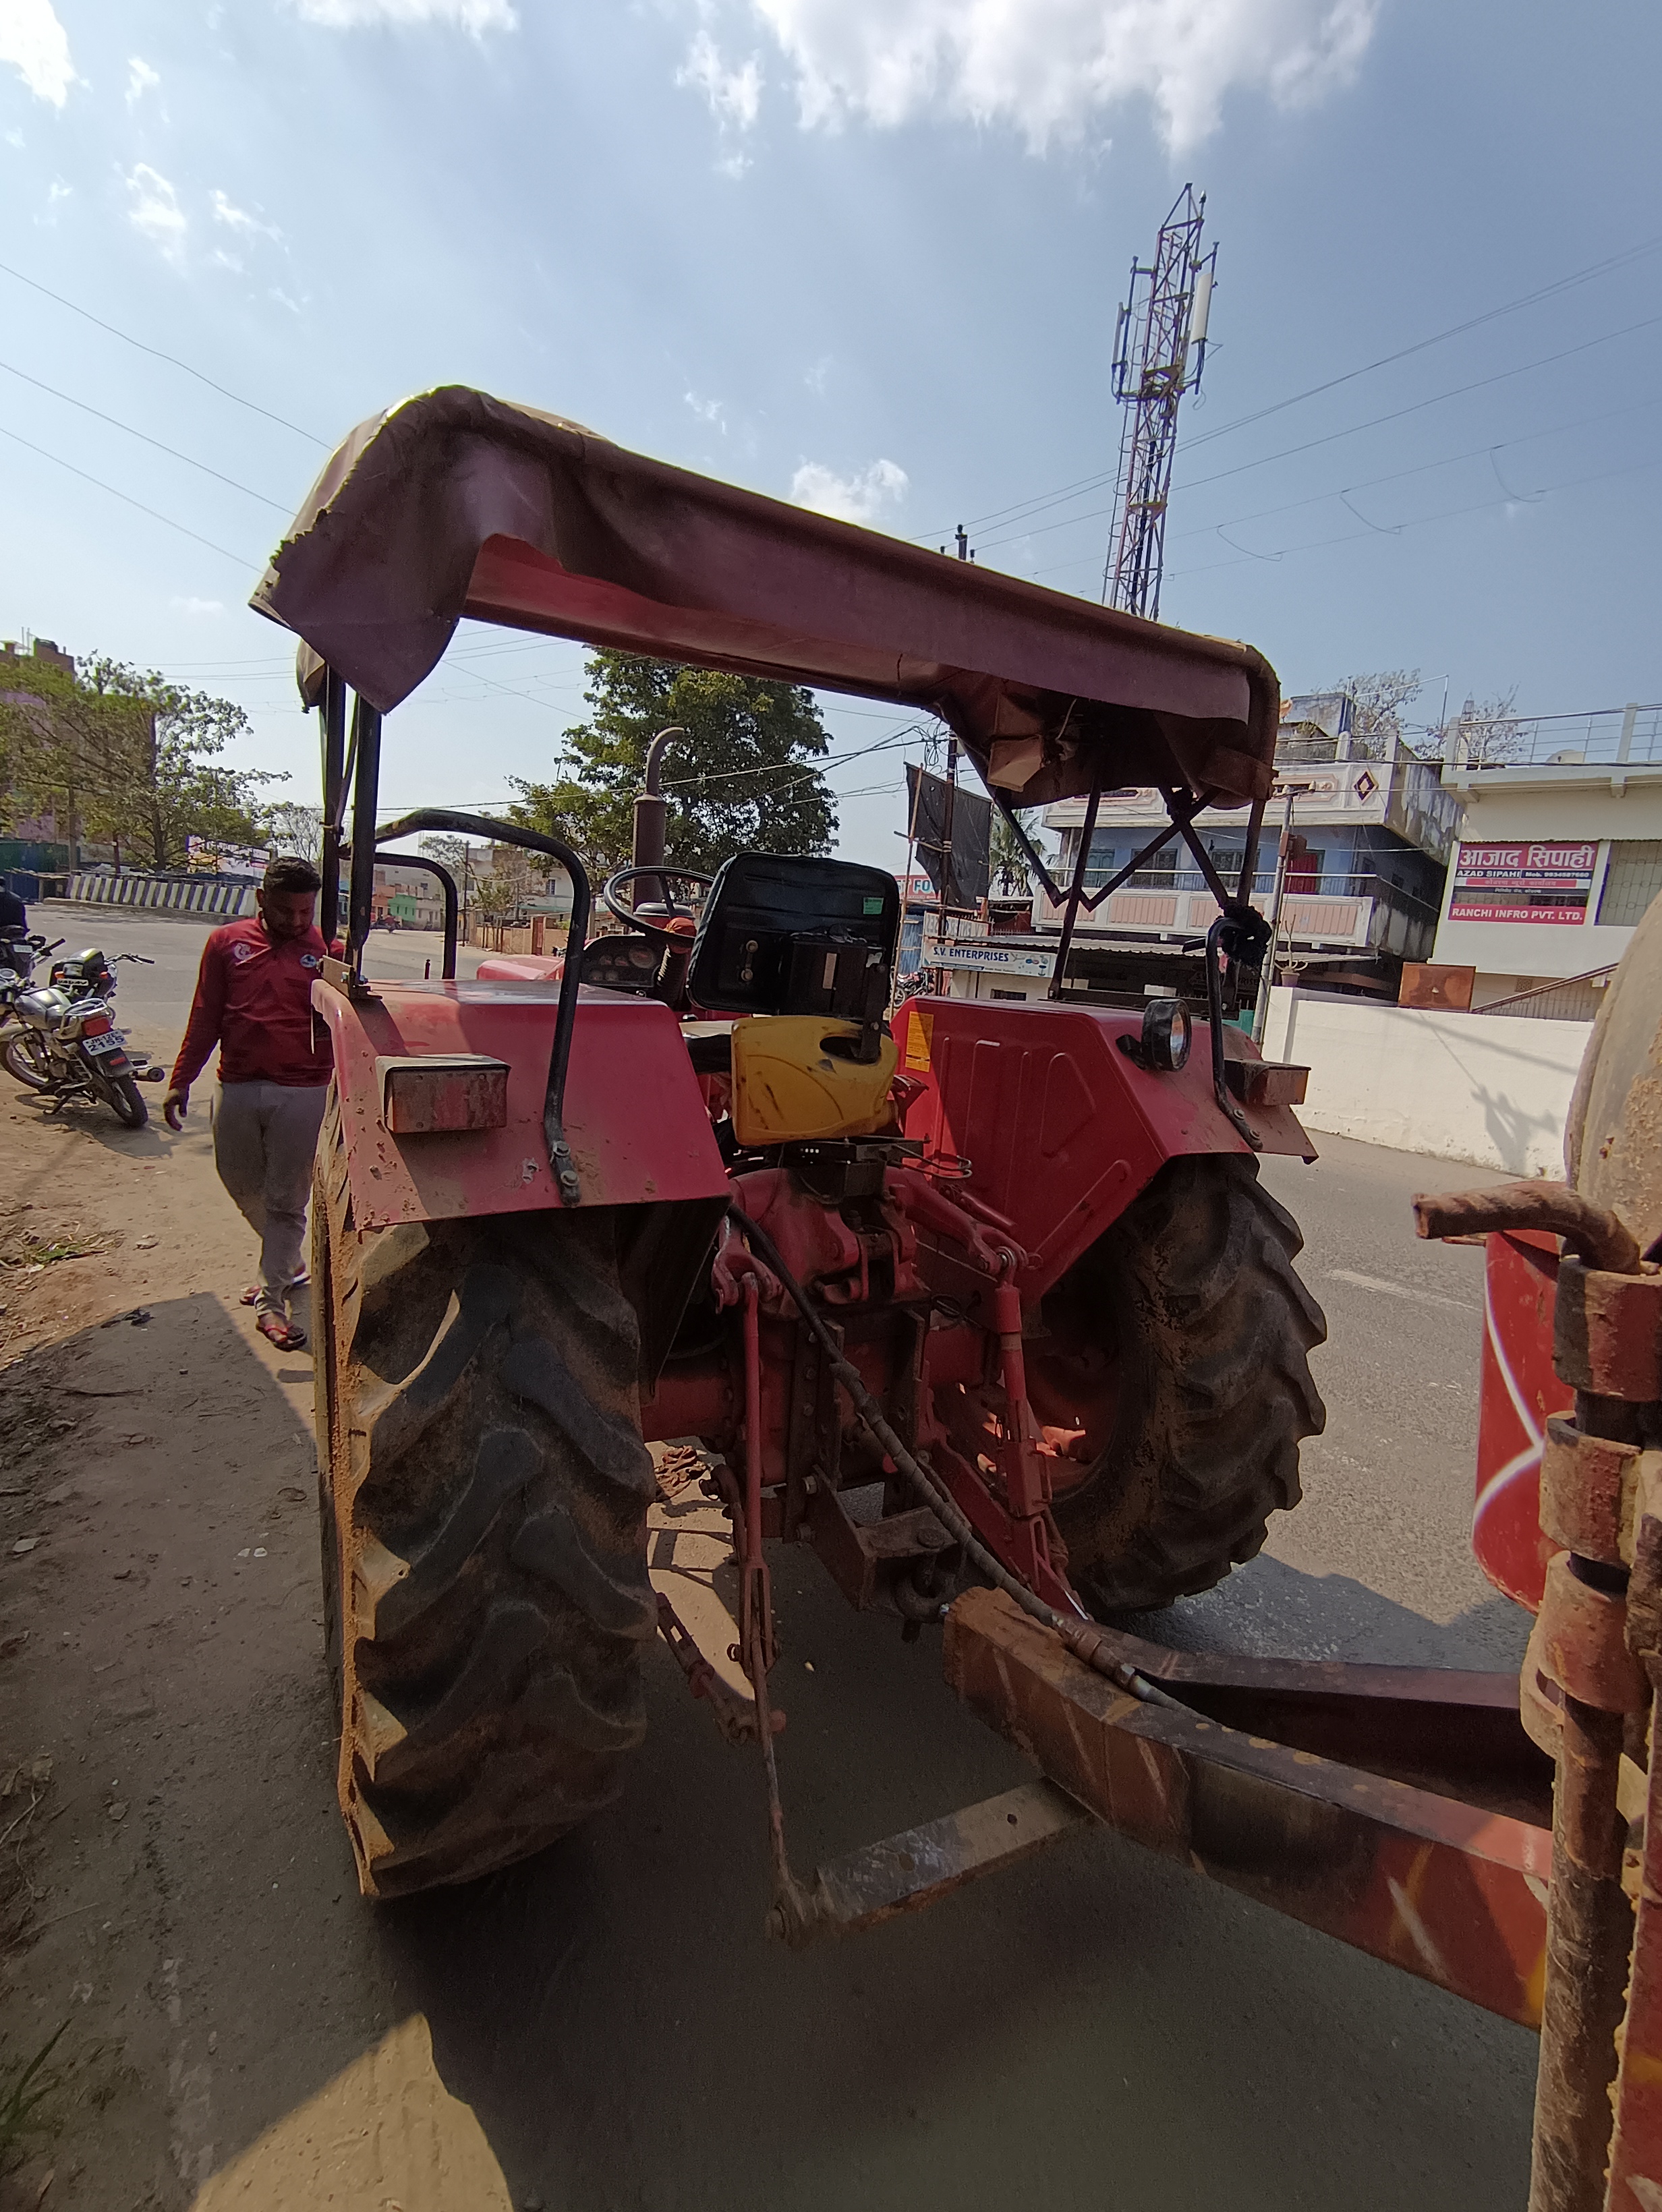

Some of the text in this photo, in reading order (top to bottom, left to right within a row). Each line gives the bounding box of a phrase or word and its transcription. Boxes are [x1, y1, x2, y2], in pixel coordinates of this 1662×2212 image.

[1460, 845, 1595, 868] आजाद सिपाही
[914, 879, 934, 892] FO
[1452, 908, 1582, 921] RANCHI INFRO PVT. LTD.
[934, 947, 1009, 962] S.V. ENTERPRISES
[88, 1036, 124, 1051] 2155
